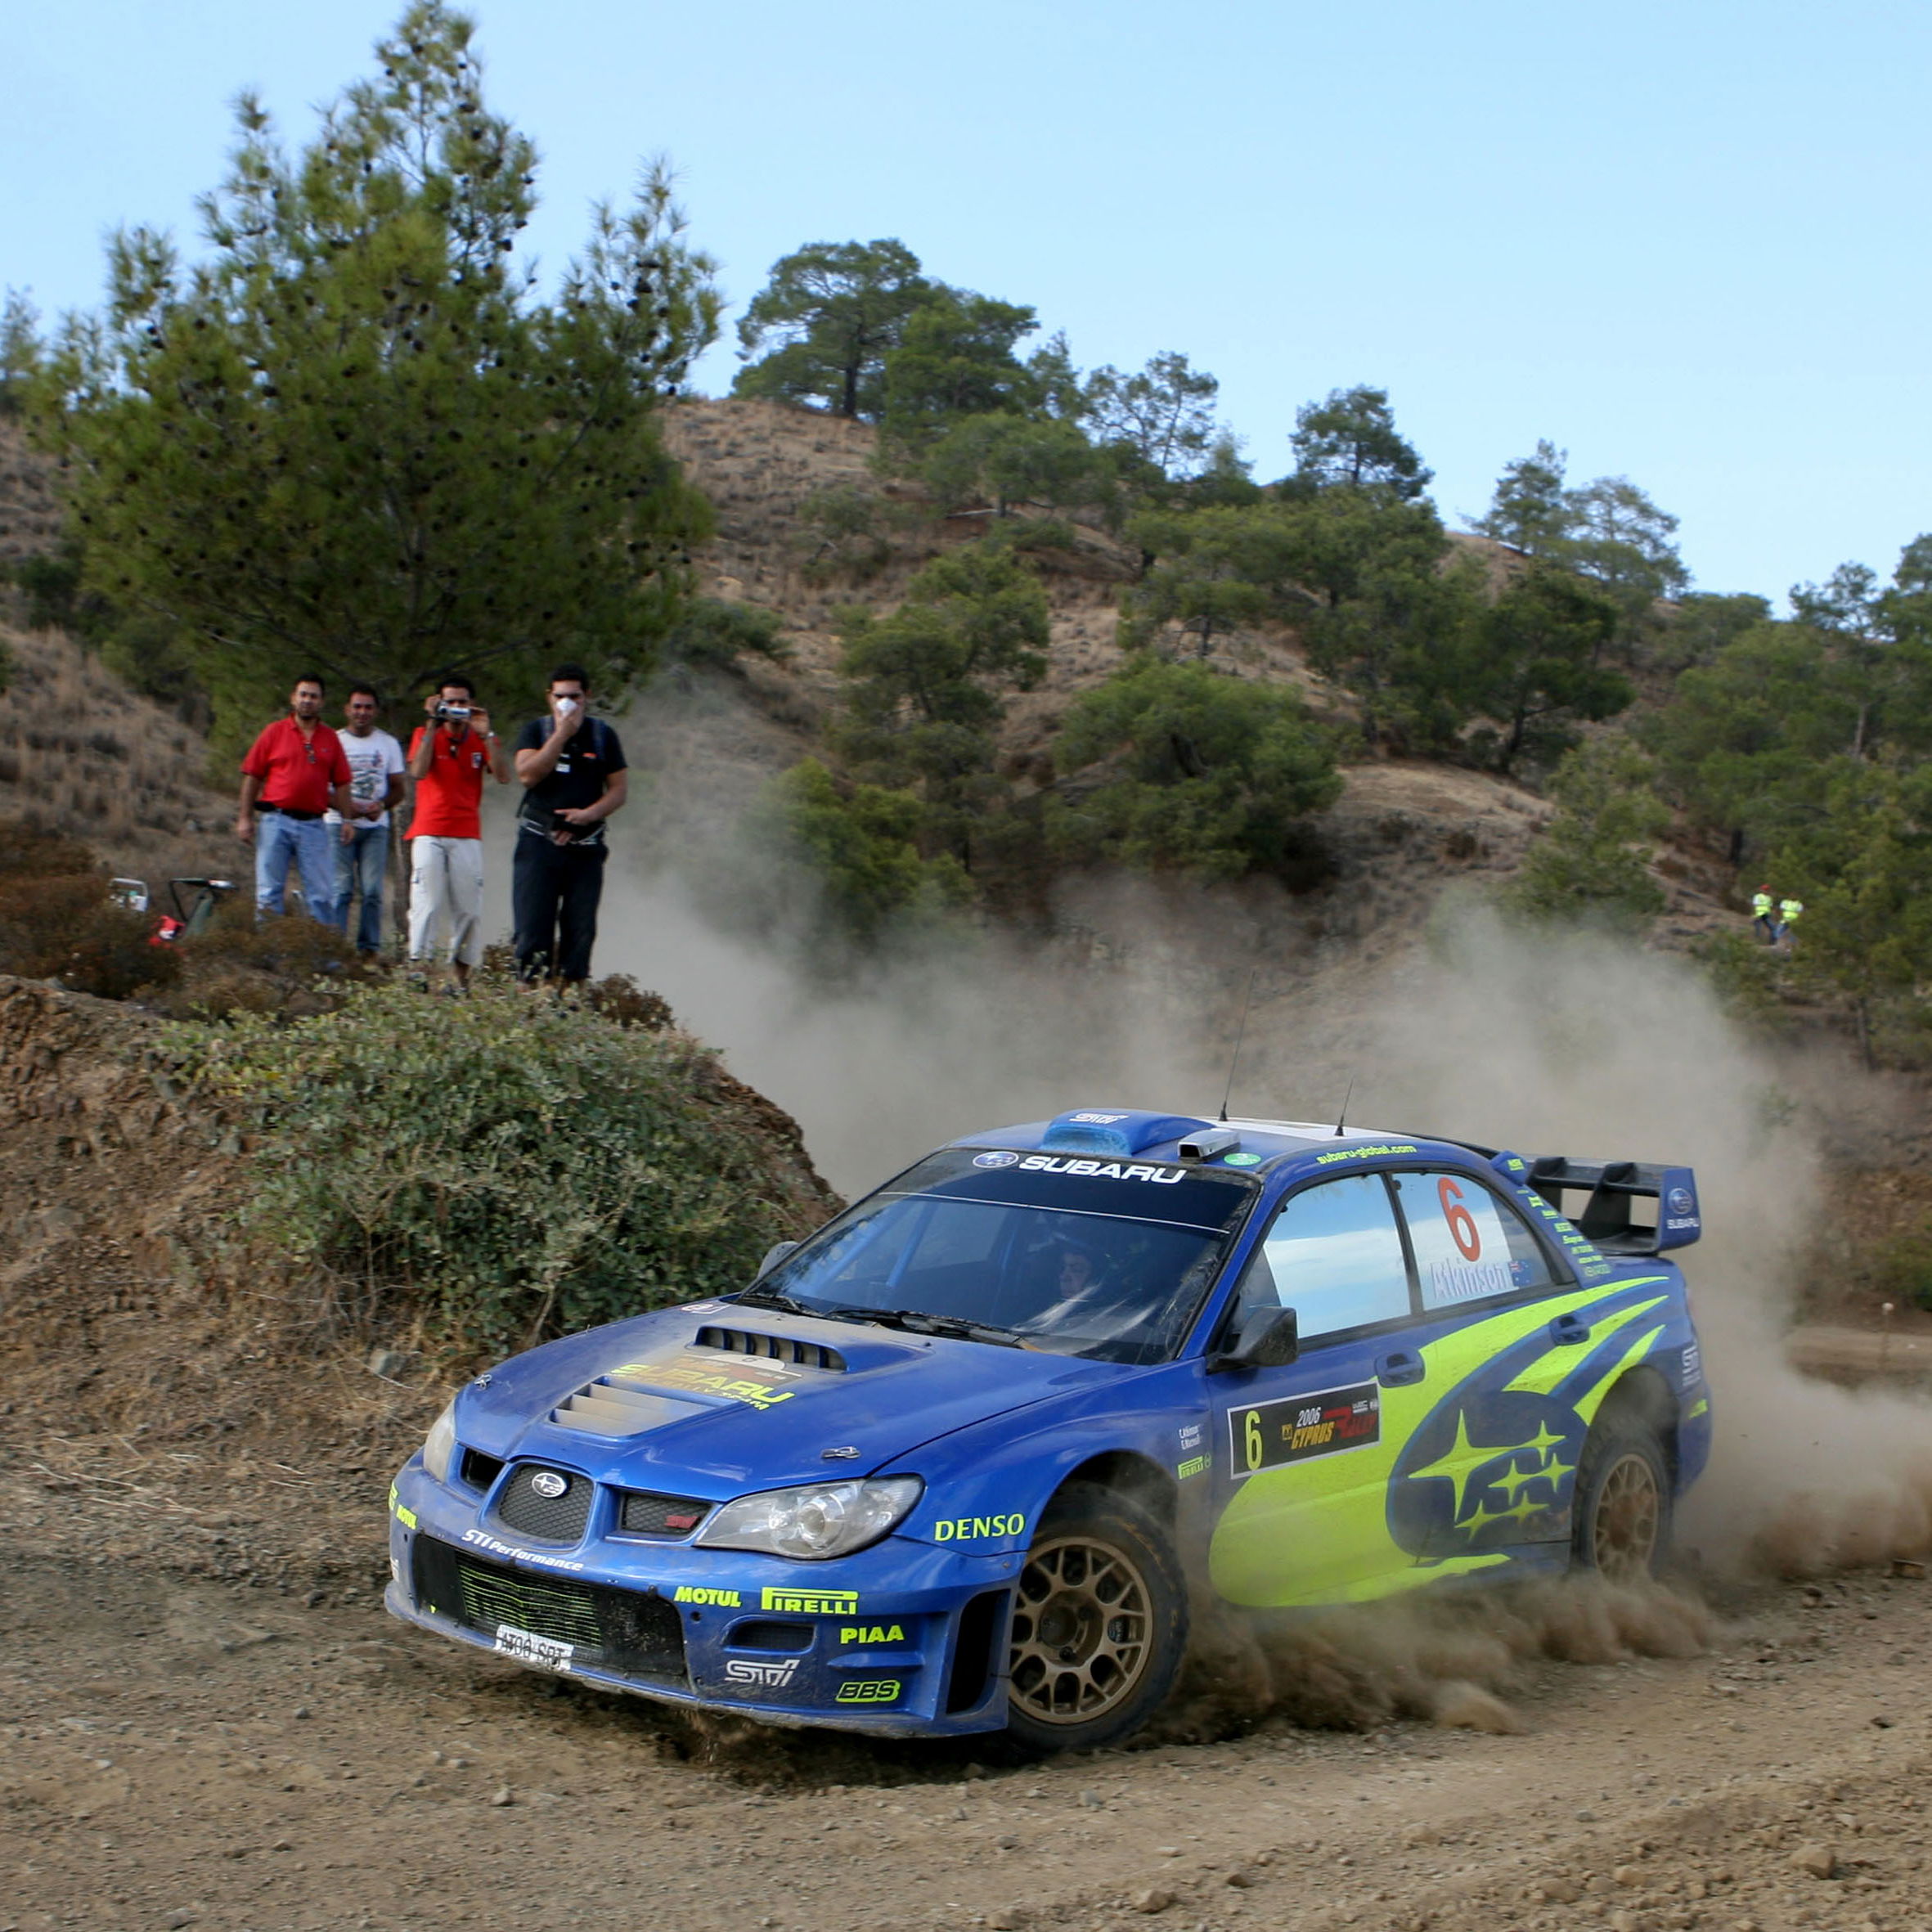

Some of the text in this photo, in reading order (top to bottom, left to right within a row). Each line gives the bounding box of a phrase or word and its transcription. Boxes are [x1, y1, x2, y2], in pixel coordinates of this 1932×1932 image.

[1316, 1144, 1418, 1165] subaru-global.com
[1018, 1155, 1188, 1184] SUBARU
[1437, 1176, 1480, 1262] 6
[610, 1364, 795, 1404] SUBARU
[1296, 1406, 1322, 1427] 2006
[1245, 1410, 1263, 1471] 6
[1290, 1421, 1336, 1449] CYPRUS
[934, 1513, 1026, 1541] DENSO
[461, 1529, 585, 1571] STI Performance
[674, 1586, 742, 1607] MOTUL
[761, 1587, 859, 1615] PIRELLI
[840, 1624, 905, 1644] PIAA
[837, 1681, 900, 1702] BBS
